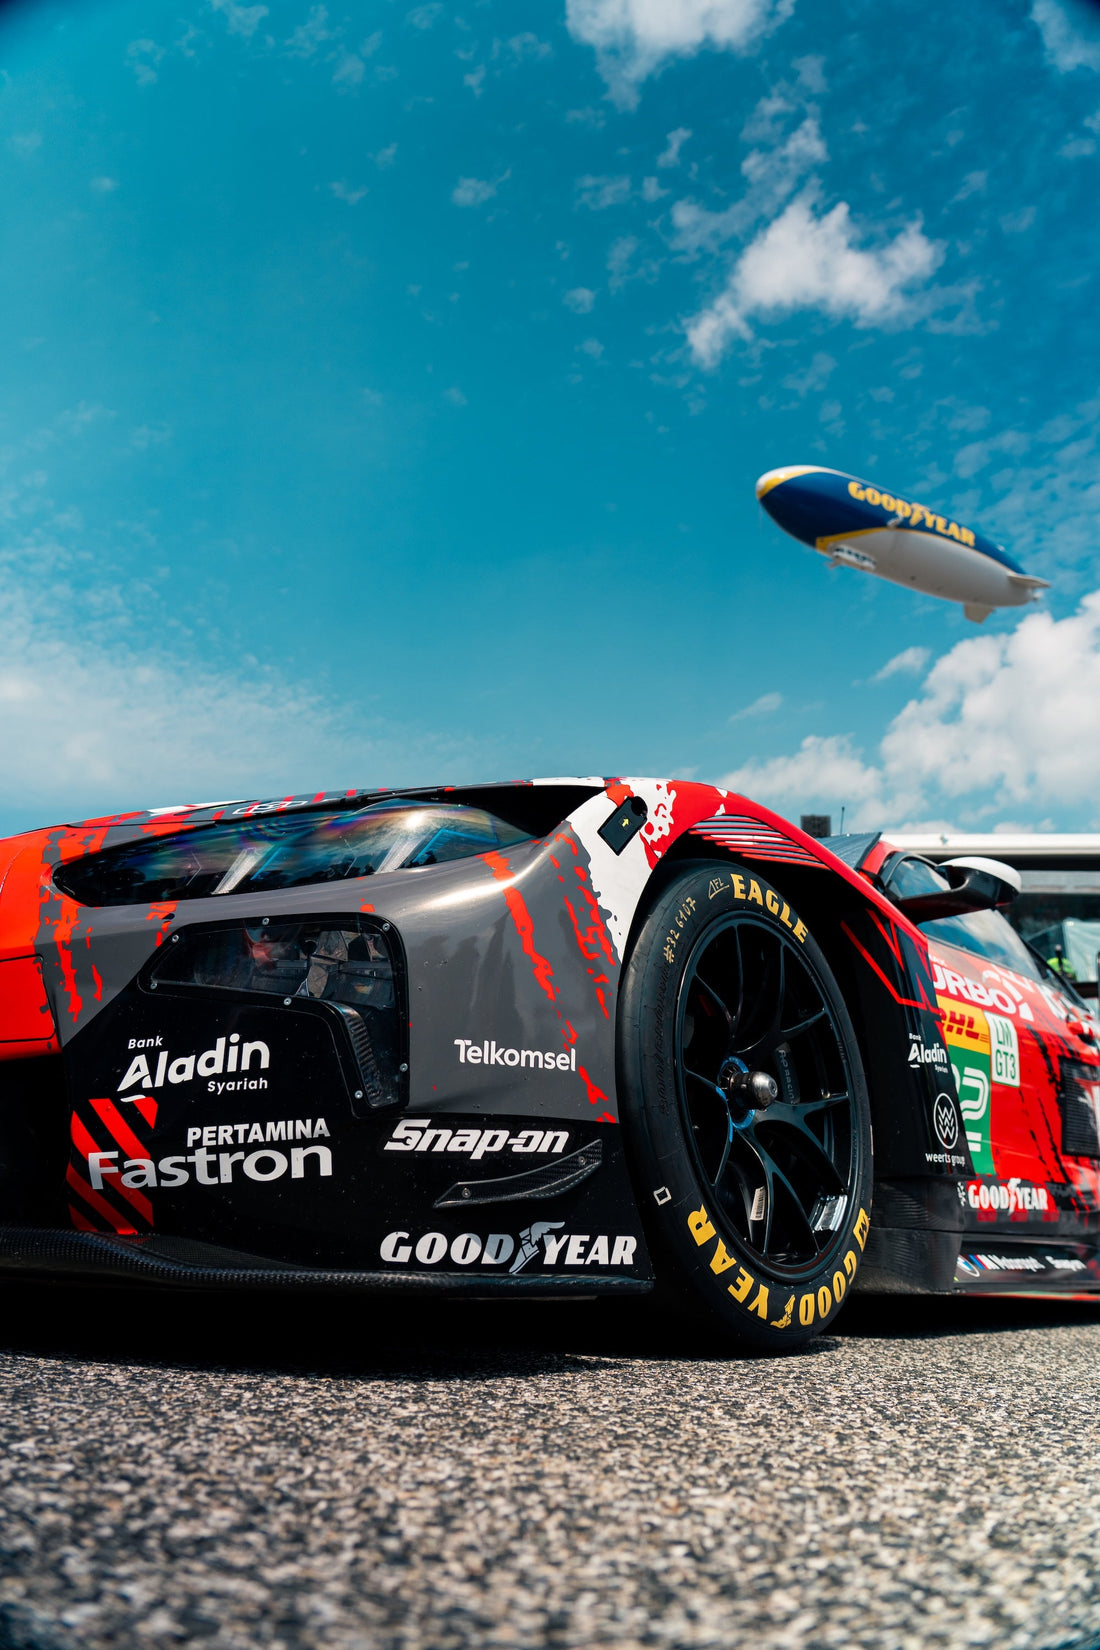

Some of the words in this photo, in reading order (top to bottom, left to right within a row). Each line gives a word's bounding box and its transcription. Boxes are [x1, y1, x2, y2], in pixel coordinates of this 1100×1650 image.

[730, 873, 809, 944] EAGLE
[127, 1035, 164, 1050] Bank
[993, 1018, 1013, 1048] LM
[117, 1033, 271, 1092] Aladin
[454, 1039, 576, 1071] Telkomsel
[908, 1043, 947, 1064] Aladin
[996, 1049, 1016, 1080] GT3
[207, 1078, 269, 1095] Syariah
[187, 1118, 331, 1147] PERTAMINA
[384, 1119, 569, 1160] Snap-on
[88, 1145, 333, 1190] Fastron
[926, 1152, 951, 1163] weerts
[968, 1183, 1048, 1210] GOODYEAR
[380, 1230, 637, 1266] GOODYEAR
[687, 1204, 857, 1328] GOODYEAR
